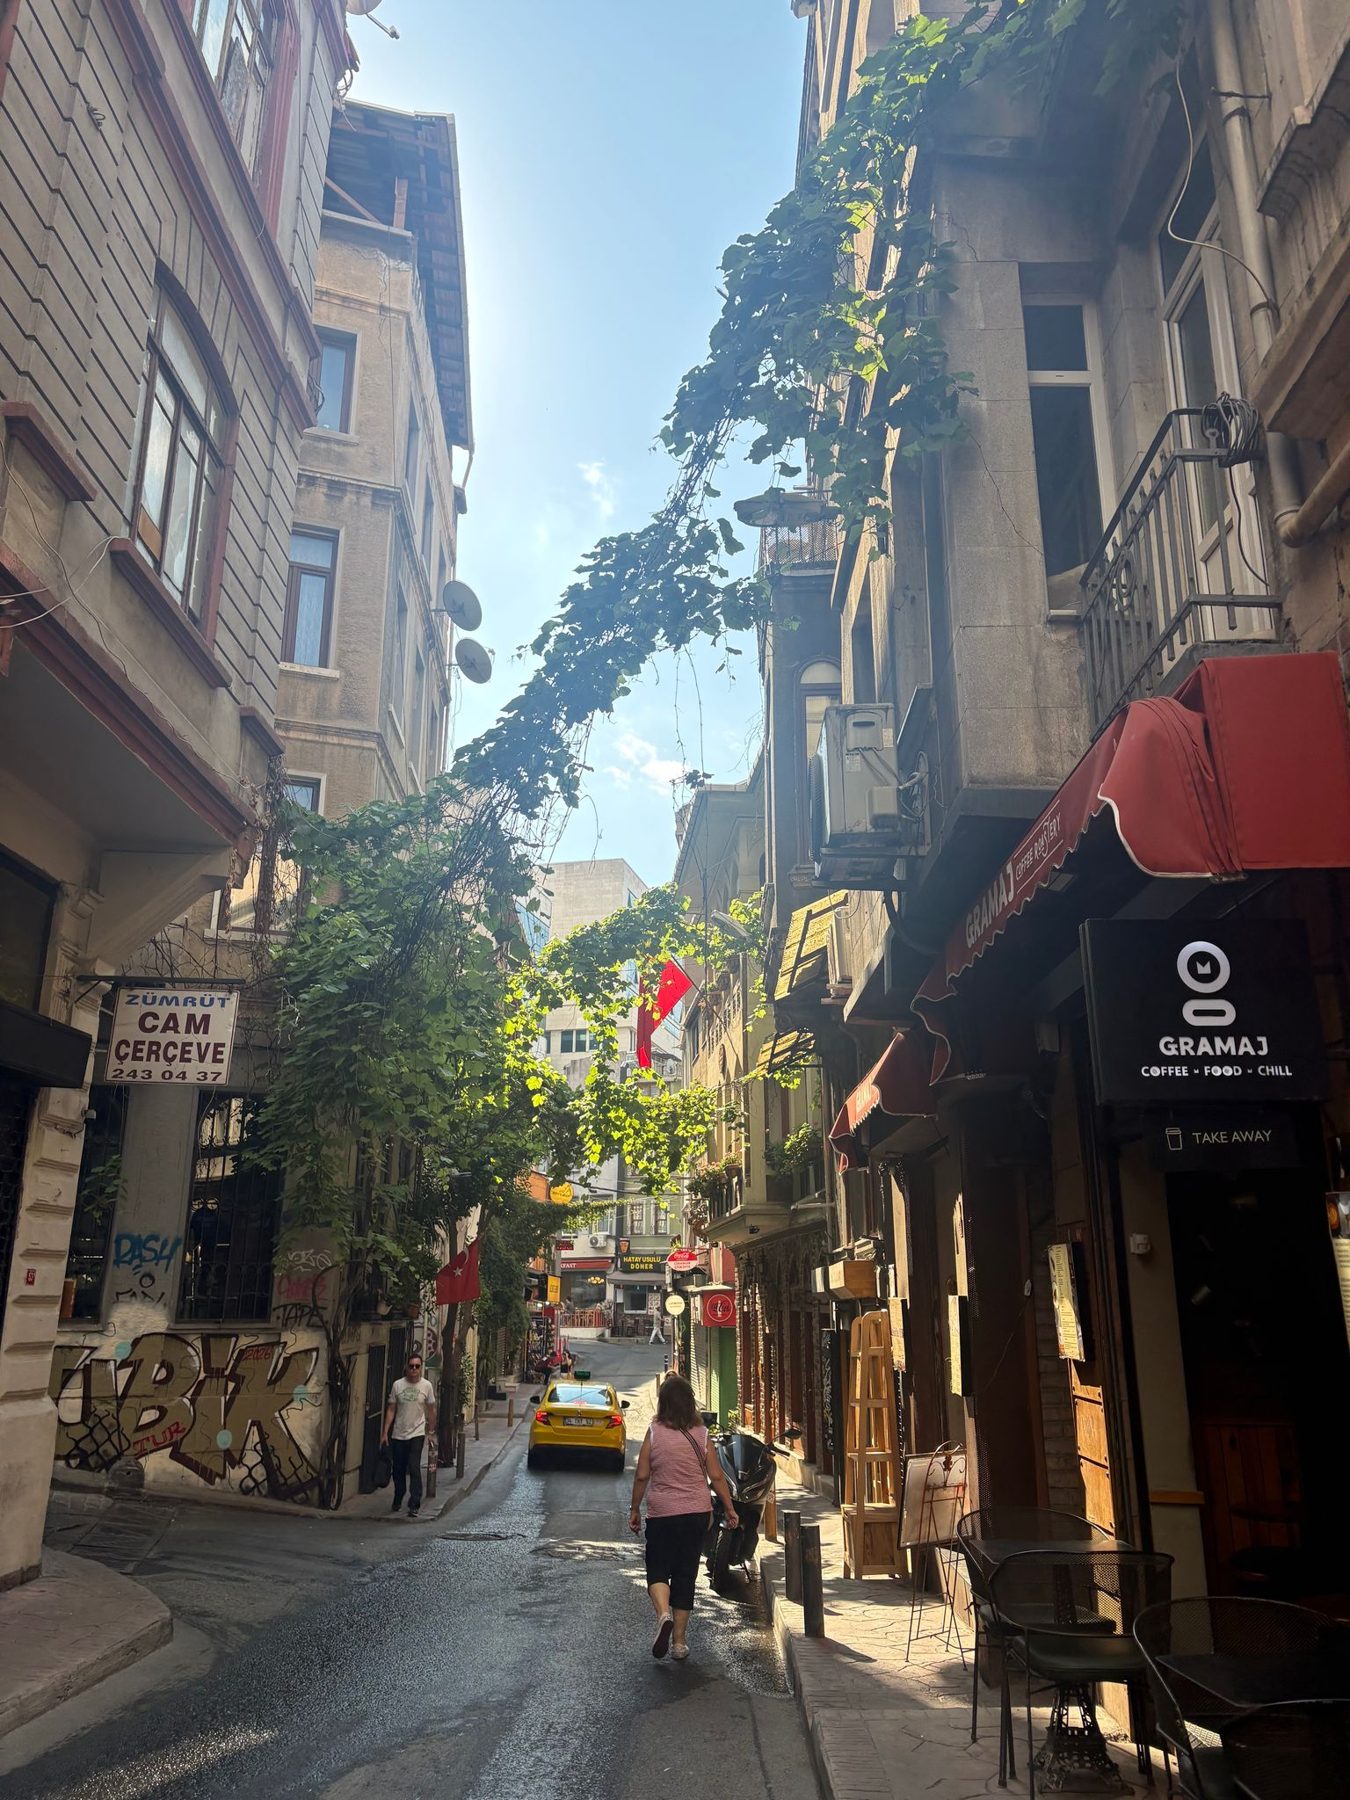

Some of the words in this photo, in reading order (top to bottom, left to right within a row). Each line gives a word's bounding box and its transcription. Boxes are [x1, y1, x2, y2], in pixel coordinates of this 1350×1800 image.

[1016, 847, 1033, 880] COFFEE
[1034, 812, 1060, 859] ROASTERY
[965, 861, 1014, 948] GRAMAJ
[125, 992, 231, 1008] ZÜMRÜT
[138, 1011, 211, 1035] CAM
[114, 1039, 226, 1066] ÇERÇEVE
[1159, 1036, 1269, 1056] GRAMAJ
[112, 1068, 152, 1080] 243
[161, 1070, 187, 1081] 04
[196, 1071, 222, 1082] 37
[1141, 1066, 1189, 1077] COFFEE
[1204, 1066, 1242, 1077] FOOD
[1258, 1065, 1293, 1076] CHILL
[1192, 1132, 1229, 1144] TAKE
[1231, 1130, 1272, 1142] AWAY
